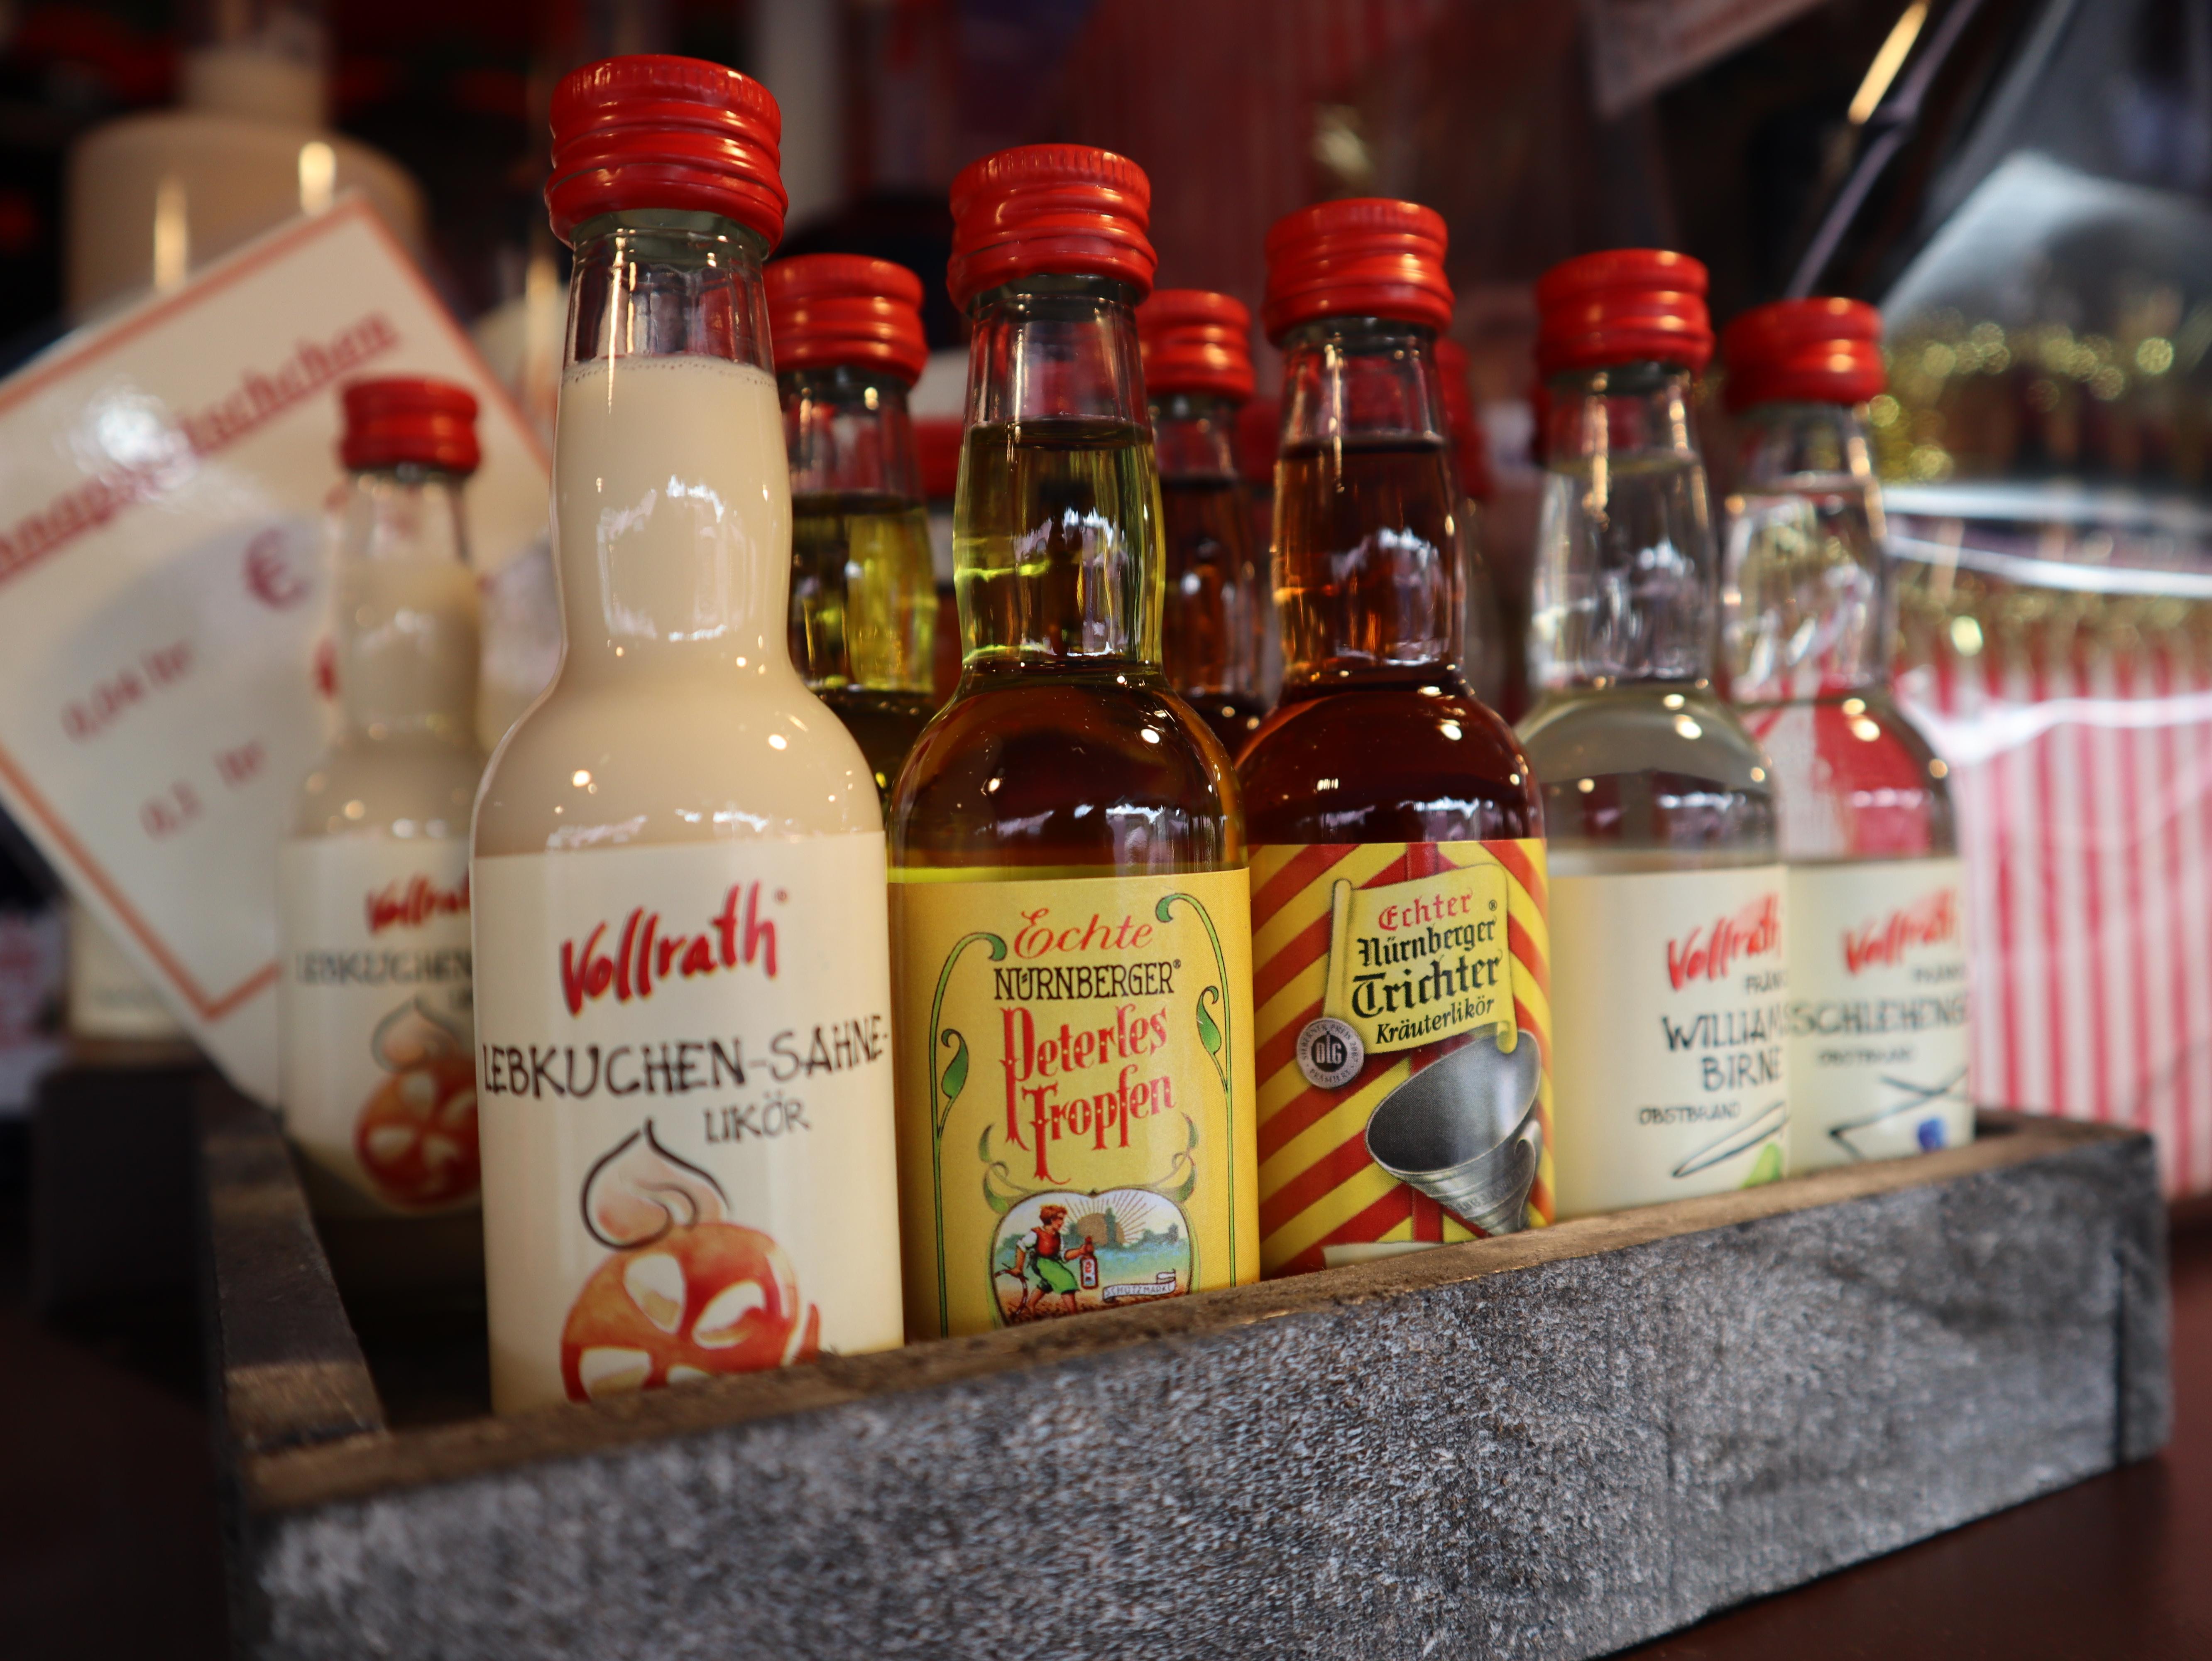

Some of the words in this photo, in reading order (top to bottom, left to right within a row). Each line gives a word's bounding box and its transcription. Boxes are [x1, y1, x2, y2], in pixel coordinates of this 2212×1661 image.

[1014, 908, 1154, 960] Echte
[1379, 887, 1473, 931] Echter
[560, 880, 777, 1016] Vollrath
[1352, 949, 1503, 1019] Trichter
[1375, 995, 1494, 1044] Kräuterlikör
[1316, 1034, 1342, 1064] DLG
[1000, 1003, 1167, 1151] Peterles
[704, 1091, 811, 1145] LIKÖR
[1022, 1064, 1175, 1185] Tropfen
[1639, 1101, 1741, 1125] OBSTBRAND
